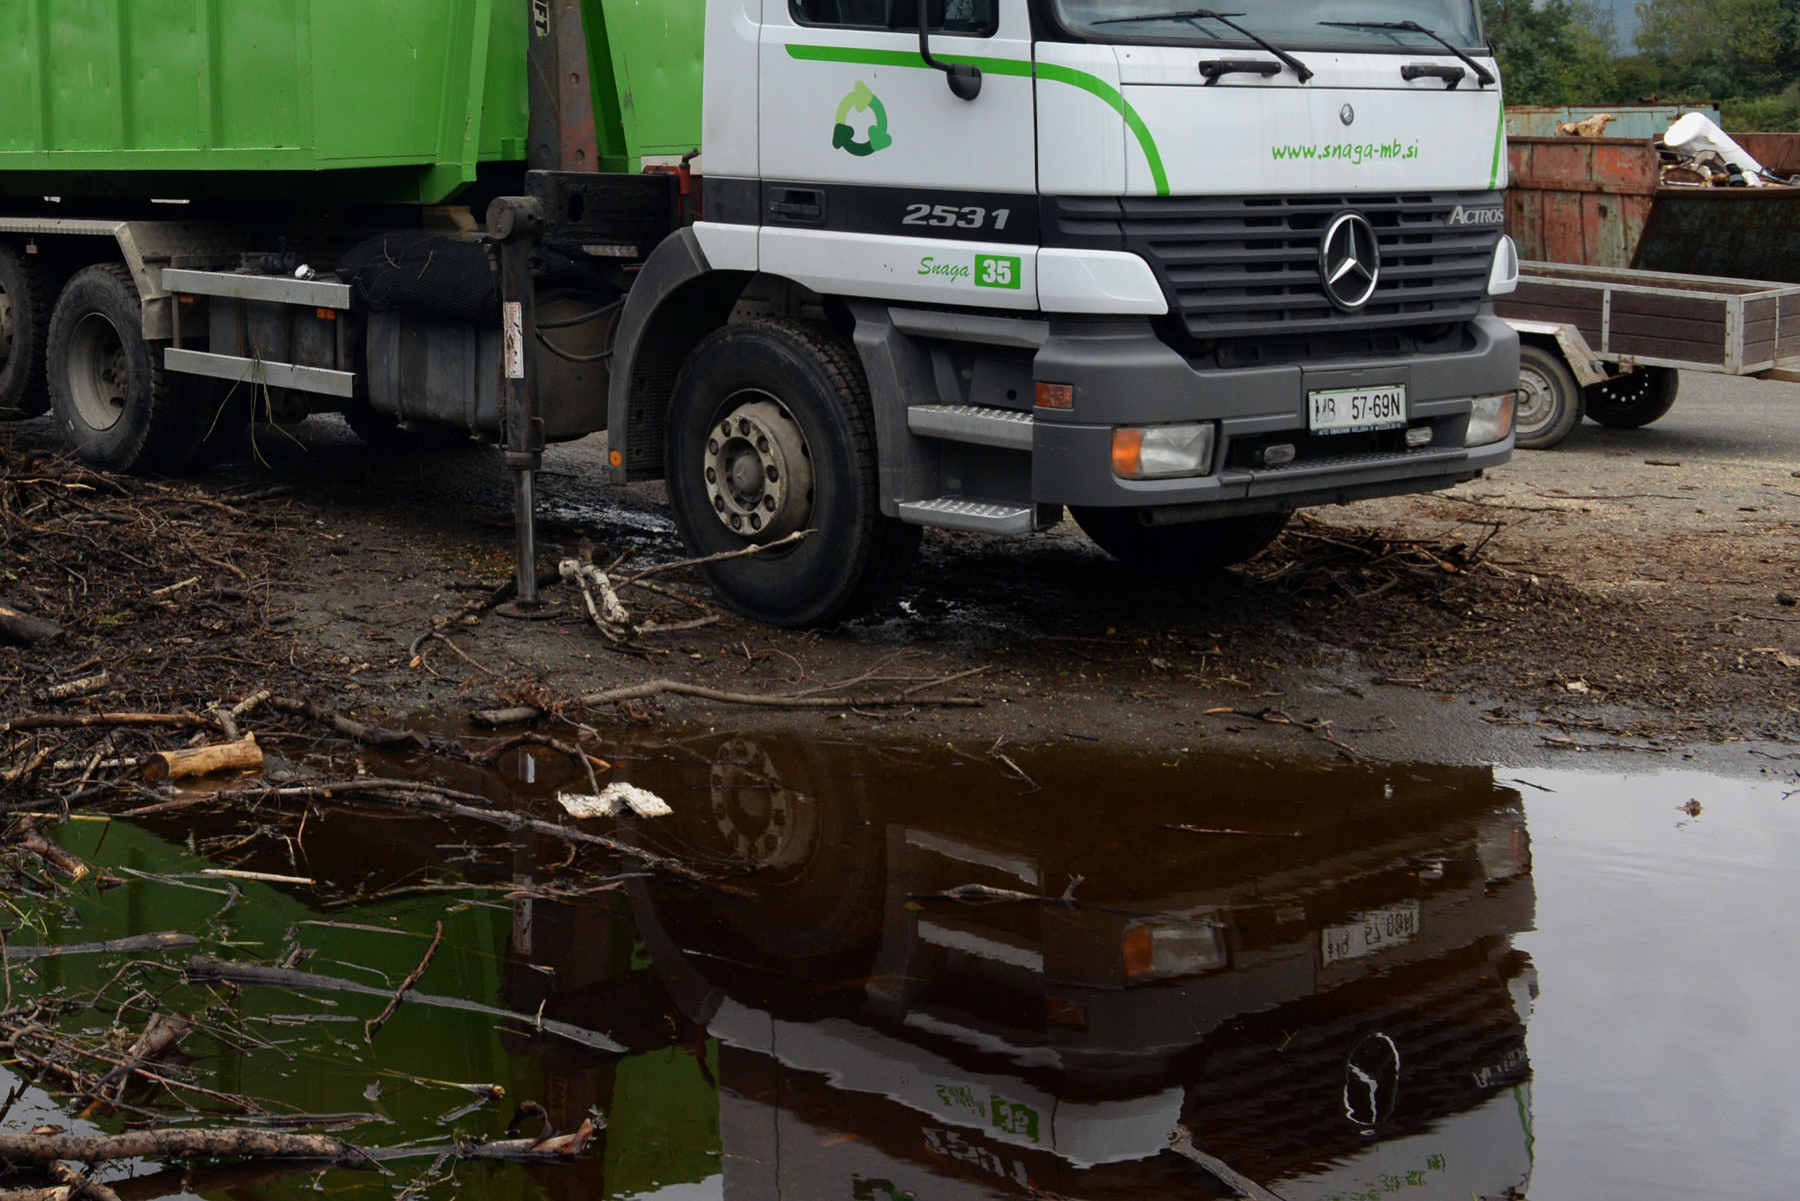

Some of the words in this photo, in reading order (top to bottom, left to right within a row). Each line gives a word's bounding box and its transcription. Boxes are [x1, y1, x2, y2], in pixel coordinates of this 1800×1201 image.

[1271, 138, 1419, 165] www.snaga-mb.si
[902, 203, 1010, 230] 2531
[917, 256, 970, 283] Snaga
[982, 259, 1012, 284] 35
[1351, 392, 1401, 420] 57-69N
